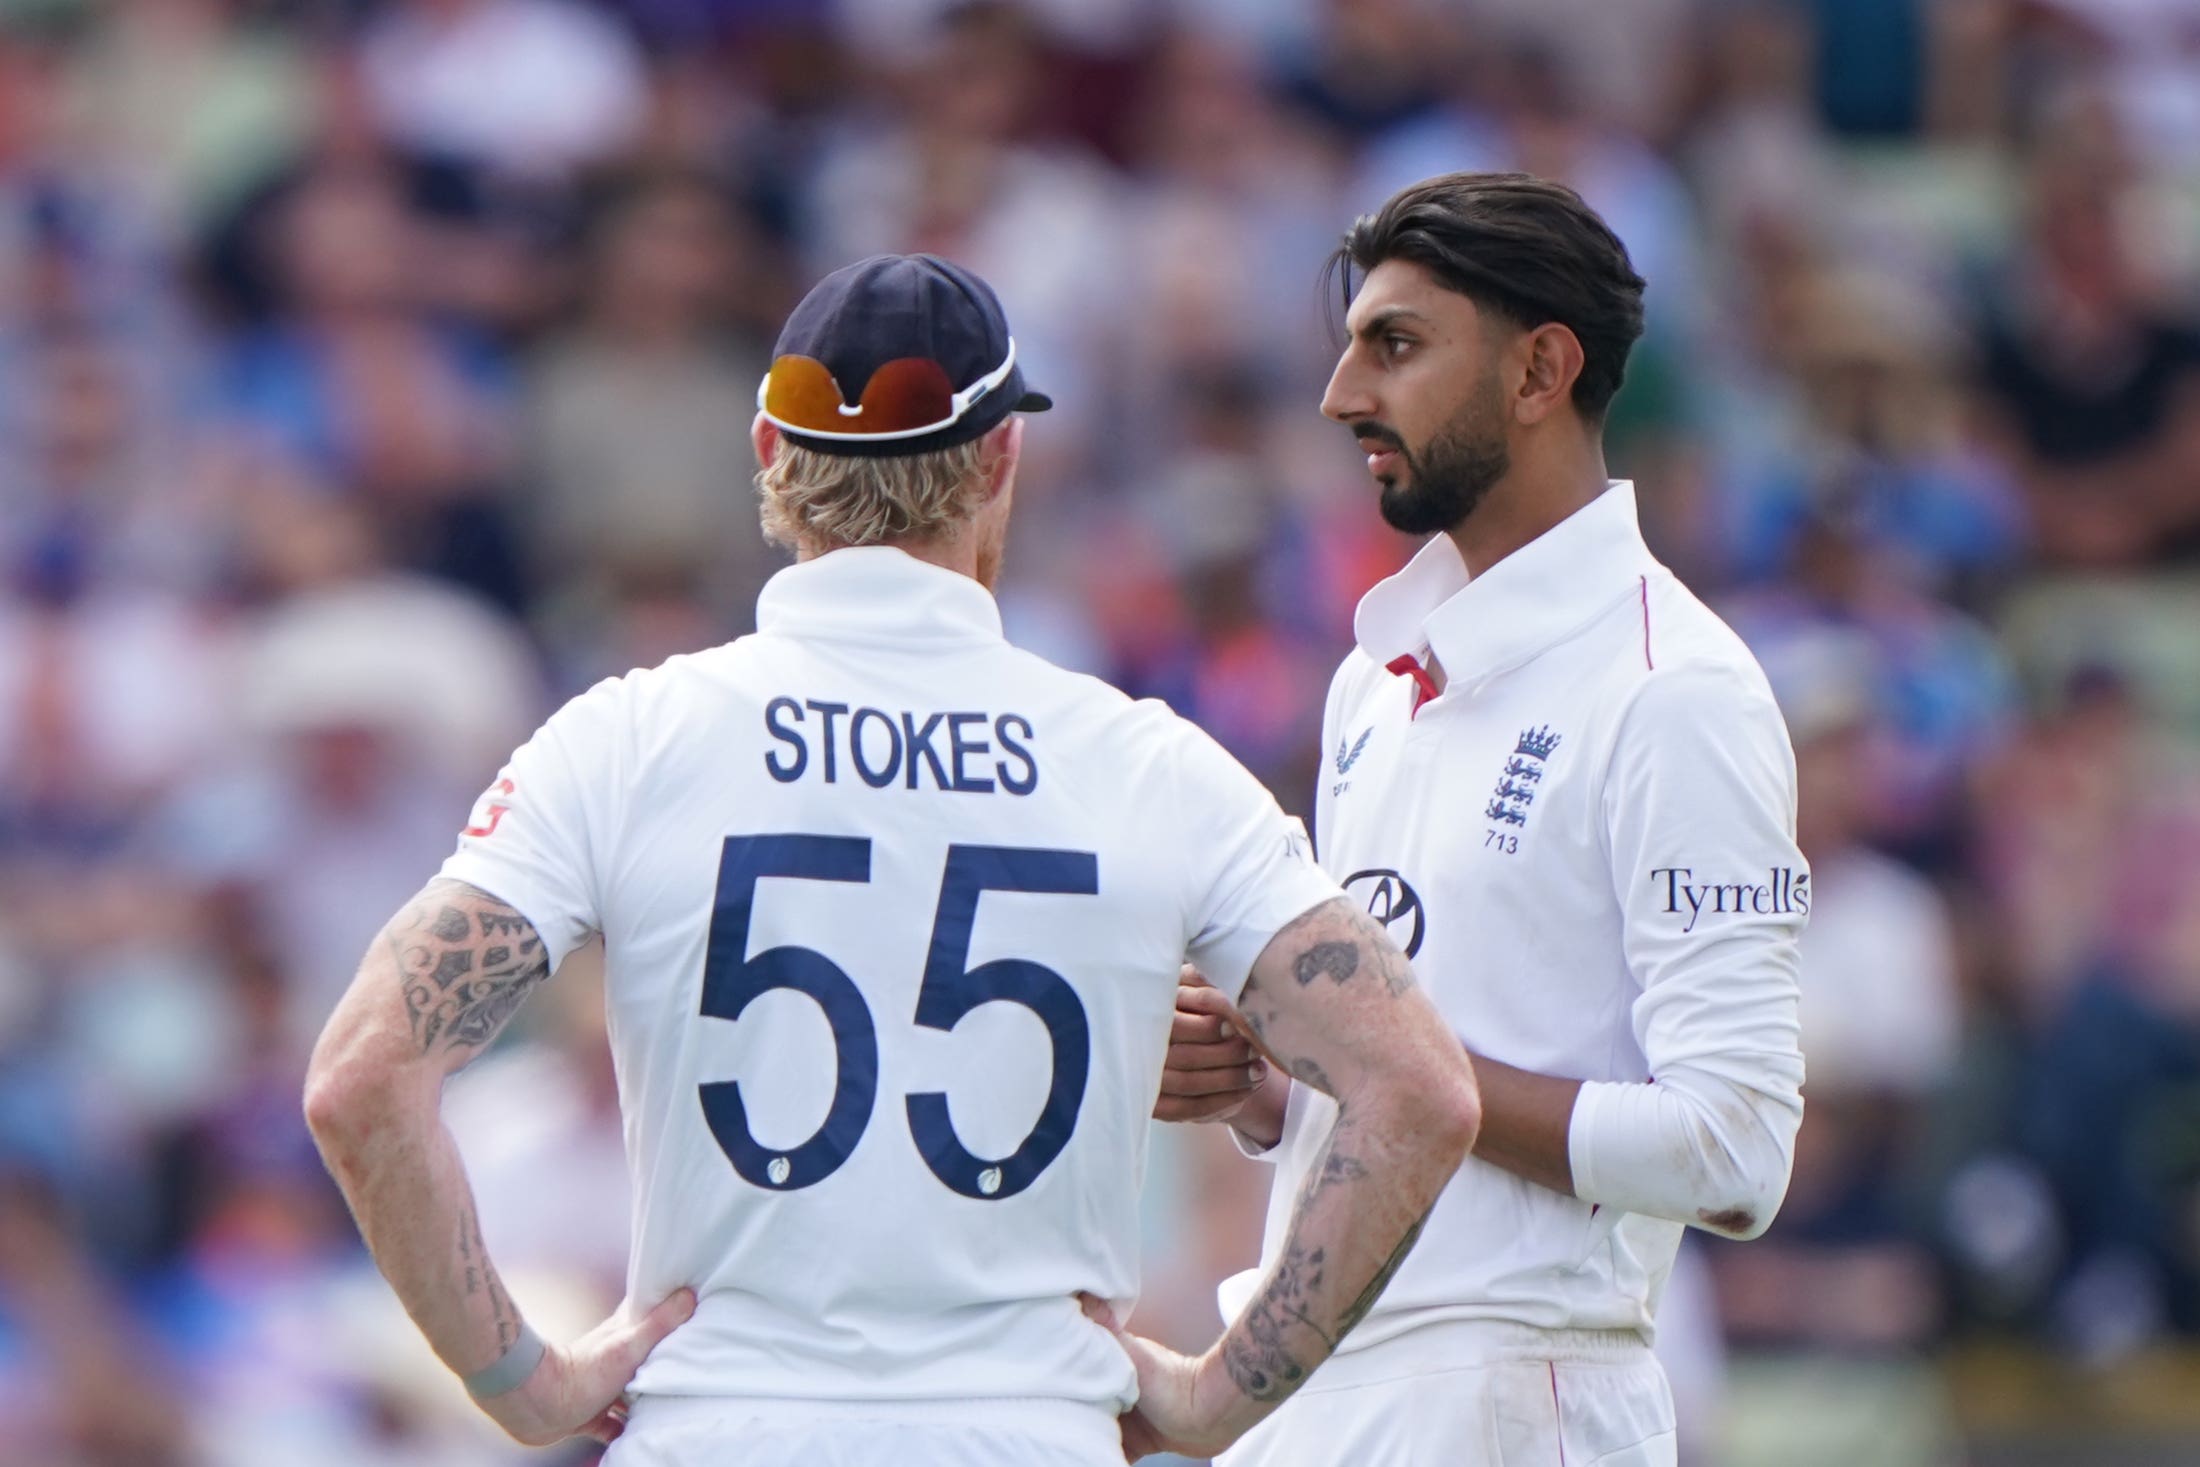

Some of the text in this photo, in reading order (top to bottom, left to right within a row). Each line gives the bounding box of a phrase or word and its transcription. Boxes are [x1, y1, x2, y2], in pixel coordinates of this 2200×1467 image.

[764, 696, 1038, 796] STOKES
[1484, 829, 1519, 855] 713
[698, 832, 1098, 1201] 55
